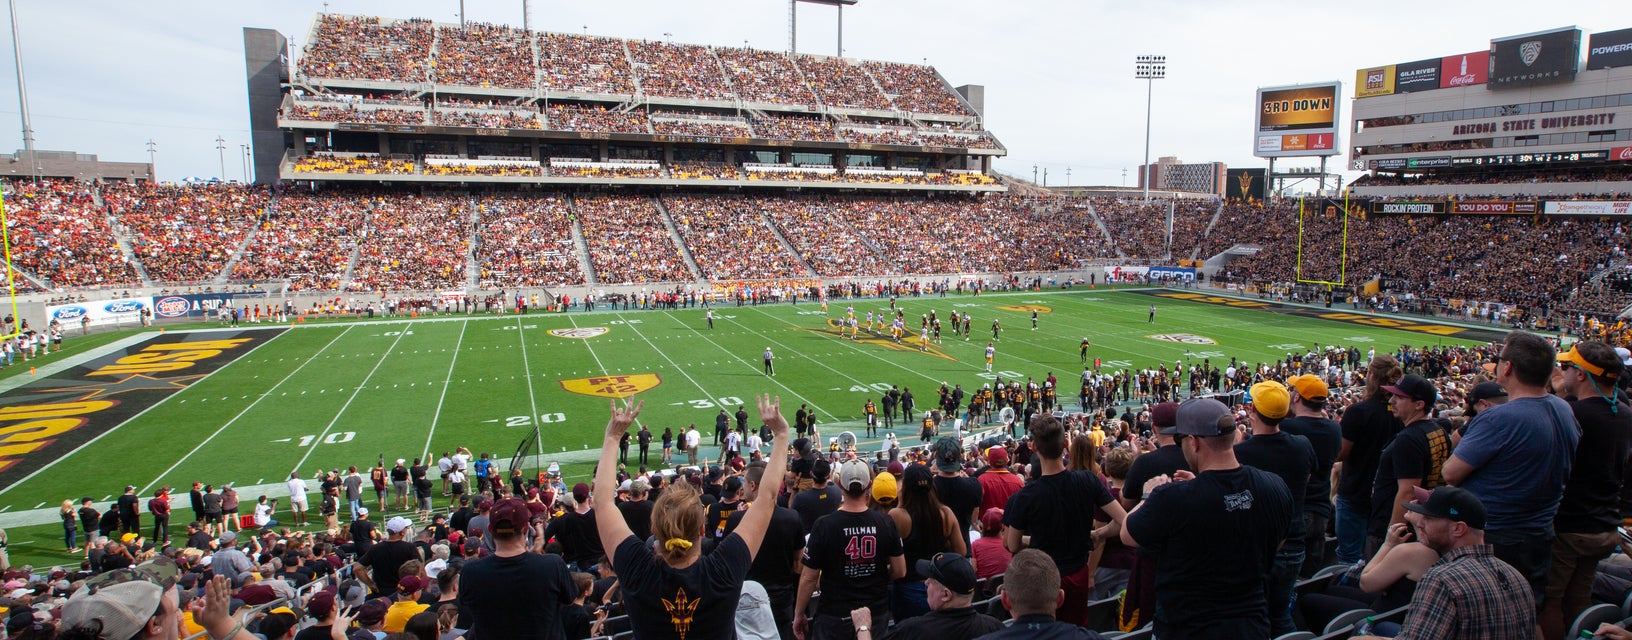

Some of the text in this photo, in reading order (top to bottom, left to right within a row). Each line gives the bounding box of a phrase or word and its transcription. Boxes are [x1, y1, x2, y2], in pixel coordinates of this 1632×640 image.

[1415, 67, 1436, 75] RIVER
[1368, 74, 1383, 83] ASU
[1450, 74, 1476, 86] Coca-Cola
[1498, 71, 1560, 83] NETWORKS
[1264, 97, 1332, 114] 3RD DOWN
[1452, 113, 1616, 135] ARIZONA STATE UNIVERSITY
[1412, 158, 1448, 166] enterprise
[1520, 154, 1533, 162] 3:04
[1408, 204, 1434, 213] PROTEIN
[1150, 270, 1194, 280] GEICO
[111, 302, 138, 312] Ford
[192, 300, 200, 310] A
[58, 310, 82, 318] Ford
[588, 376, 630, 386] PT
[596, 384, 638, 394] 42
[850, 382, 894, 392] 40
[687, 396, 744, 408] 30
[505, 412, 566, 427] 20
[298, 431, 356, 447] 10
[843, 526, 877, 536] TILLMAN
[844, 536, 877, 560] 40
